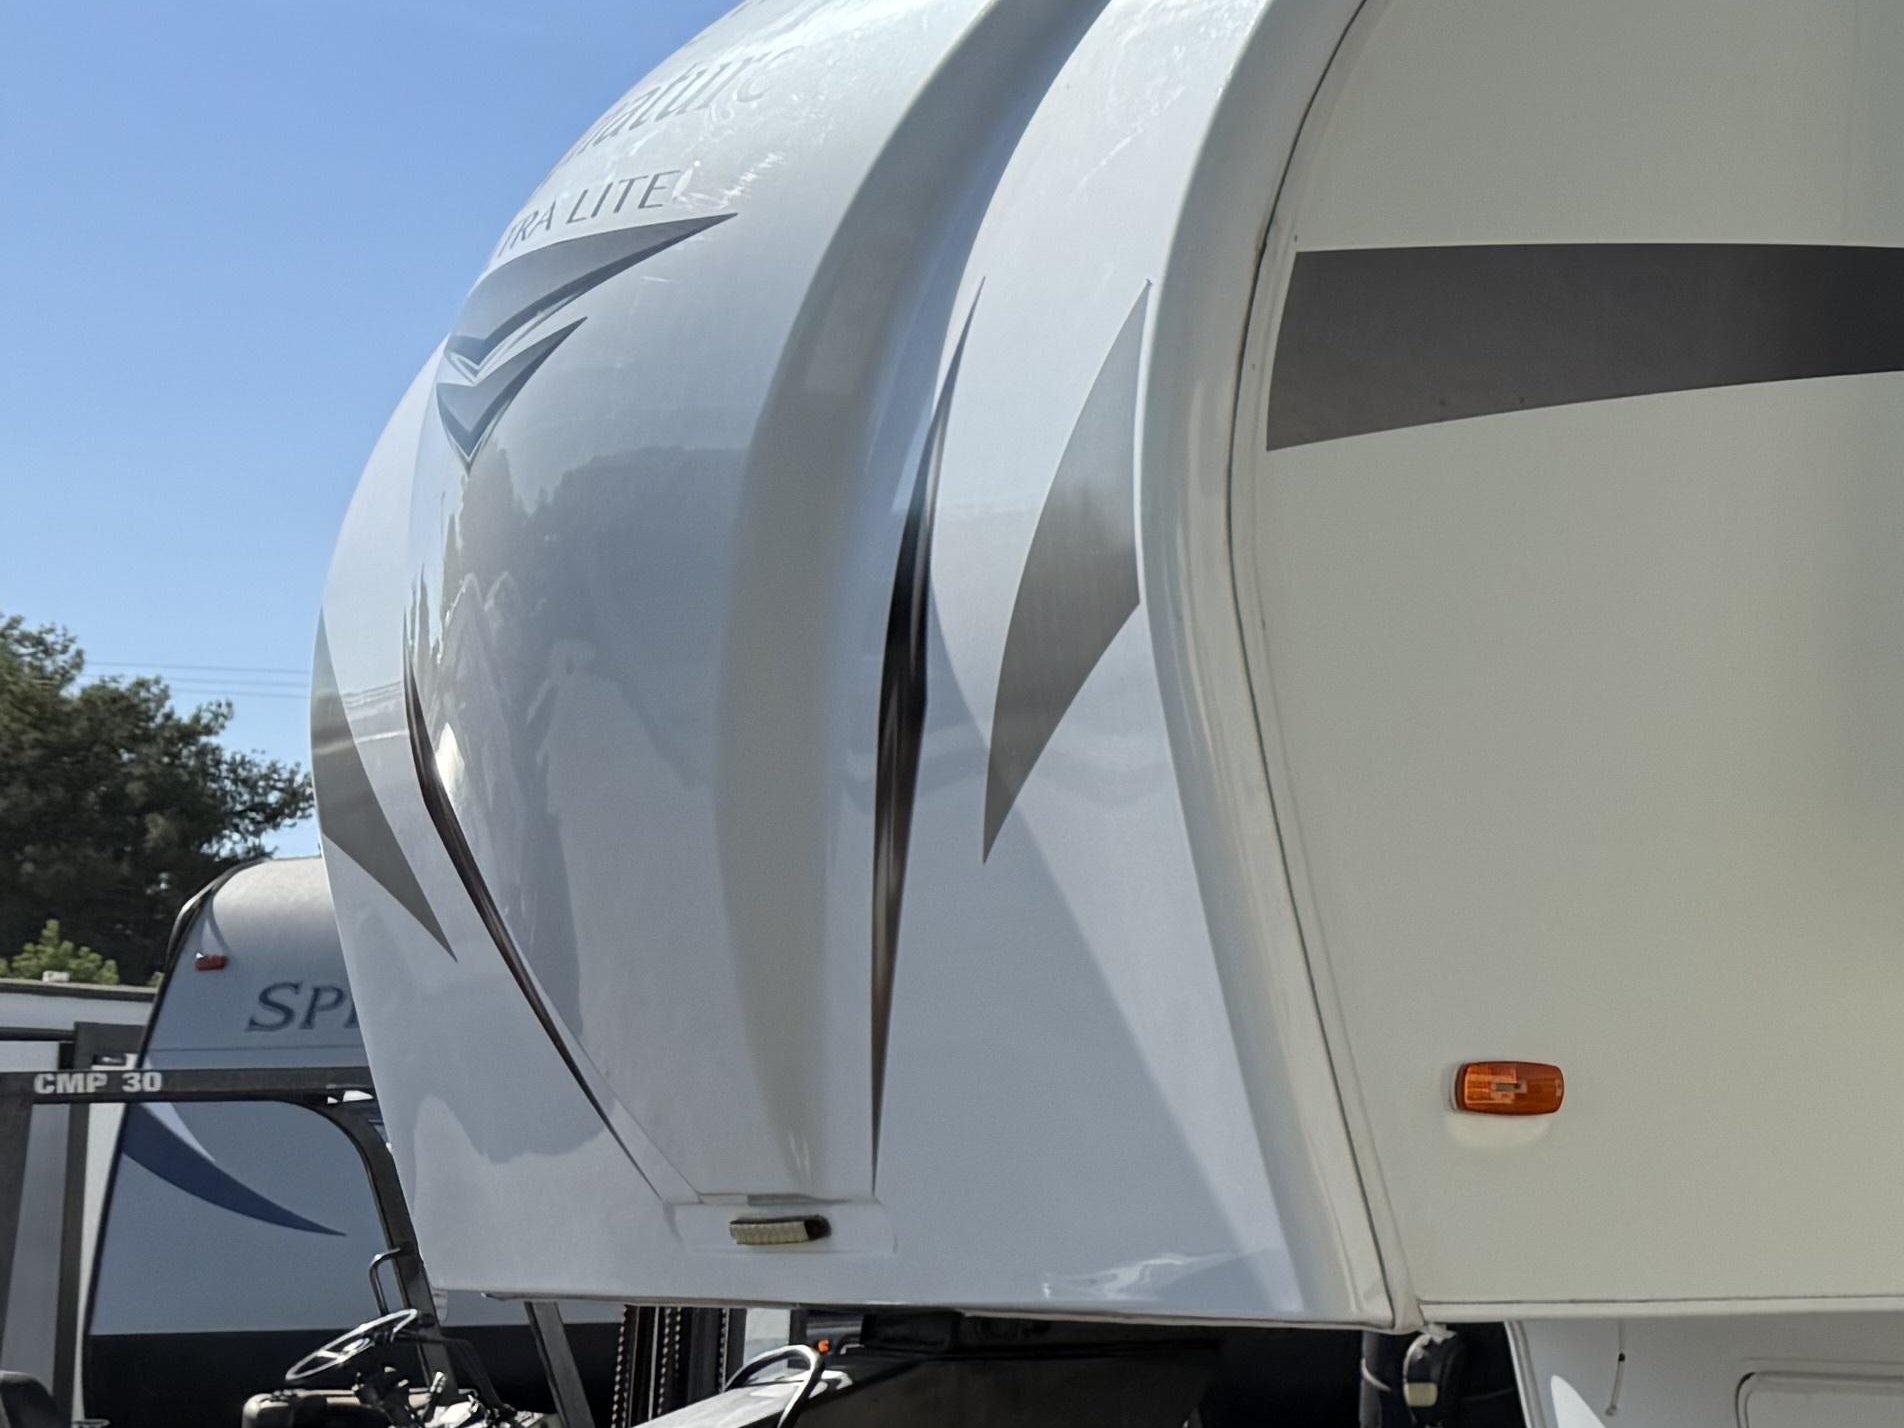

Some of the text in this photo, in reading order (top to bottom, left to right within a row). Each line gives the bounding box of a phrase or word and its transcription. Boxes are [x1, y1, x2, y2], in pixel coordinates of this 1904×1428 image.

[566, 170, 682, 225] LITE
[33, 1071, 162, 1094] CMP 30
